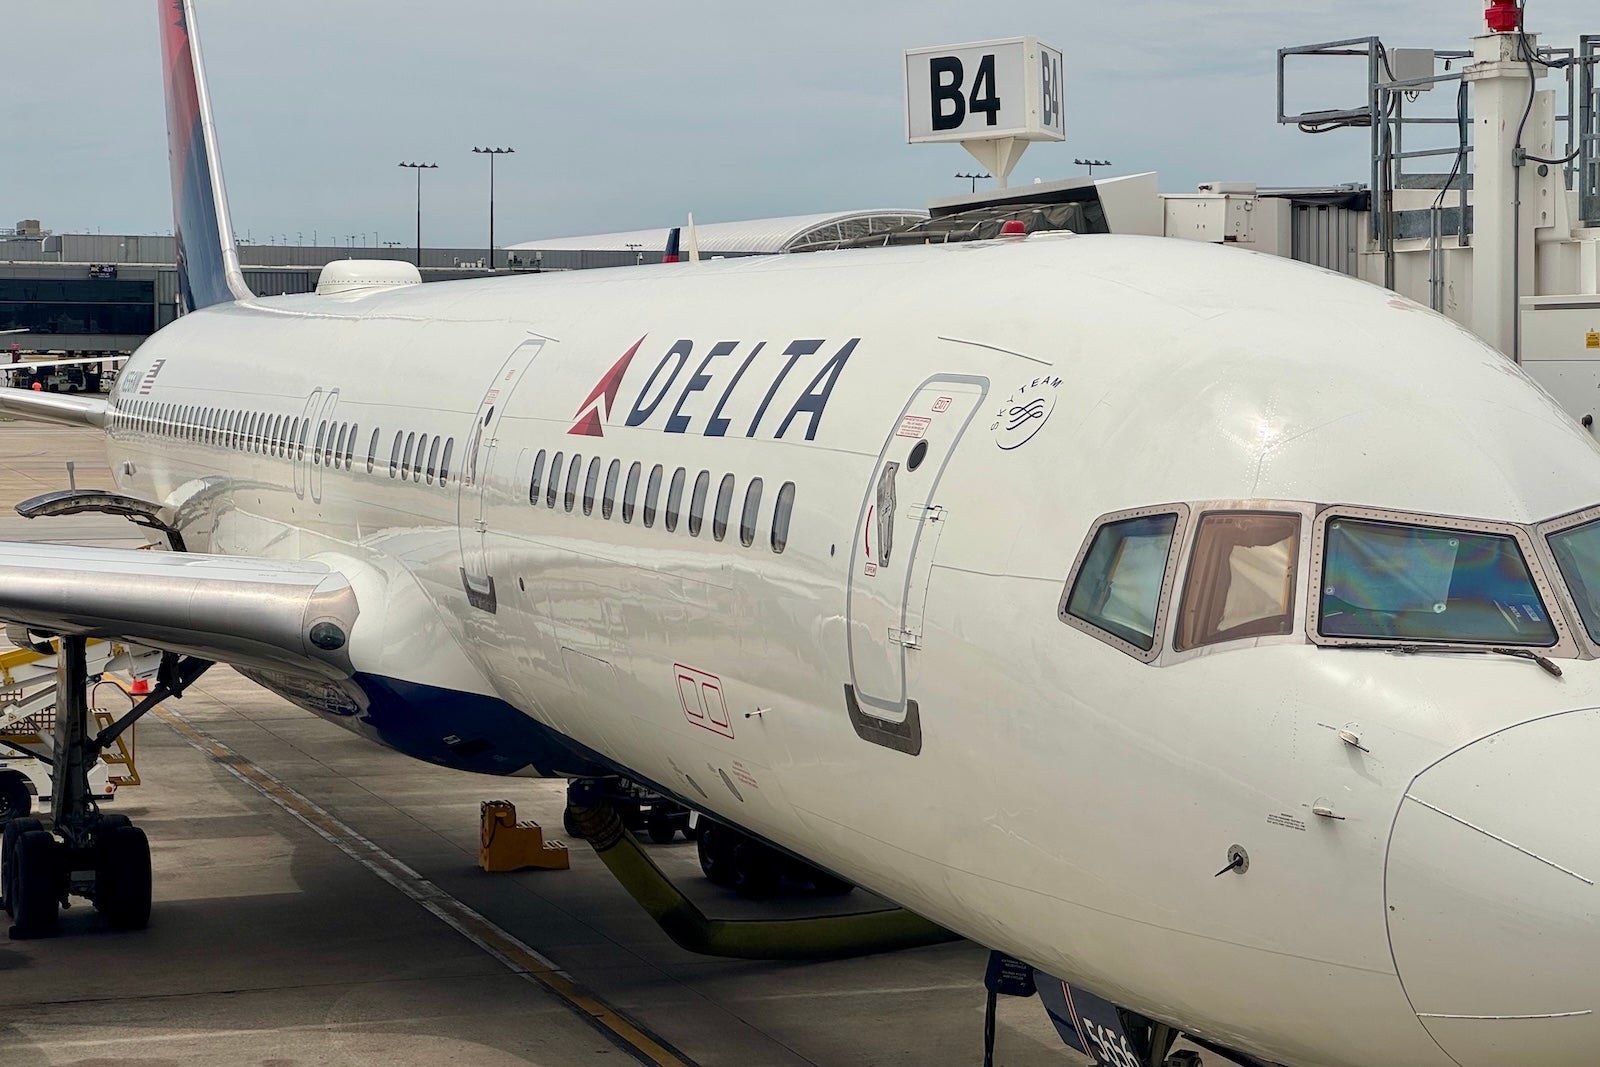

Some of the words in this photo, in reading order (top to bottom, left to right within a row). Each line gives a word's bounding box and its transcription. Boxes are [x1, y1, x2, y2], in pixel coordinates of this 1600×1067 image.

[930, 54, 1000, 131] B4
[1041, 51, 1059, 128] B4
[624, 338, 861, 441] DELTA
